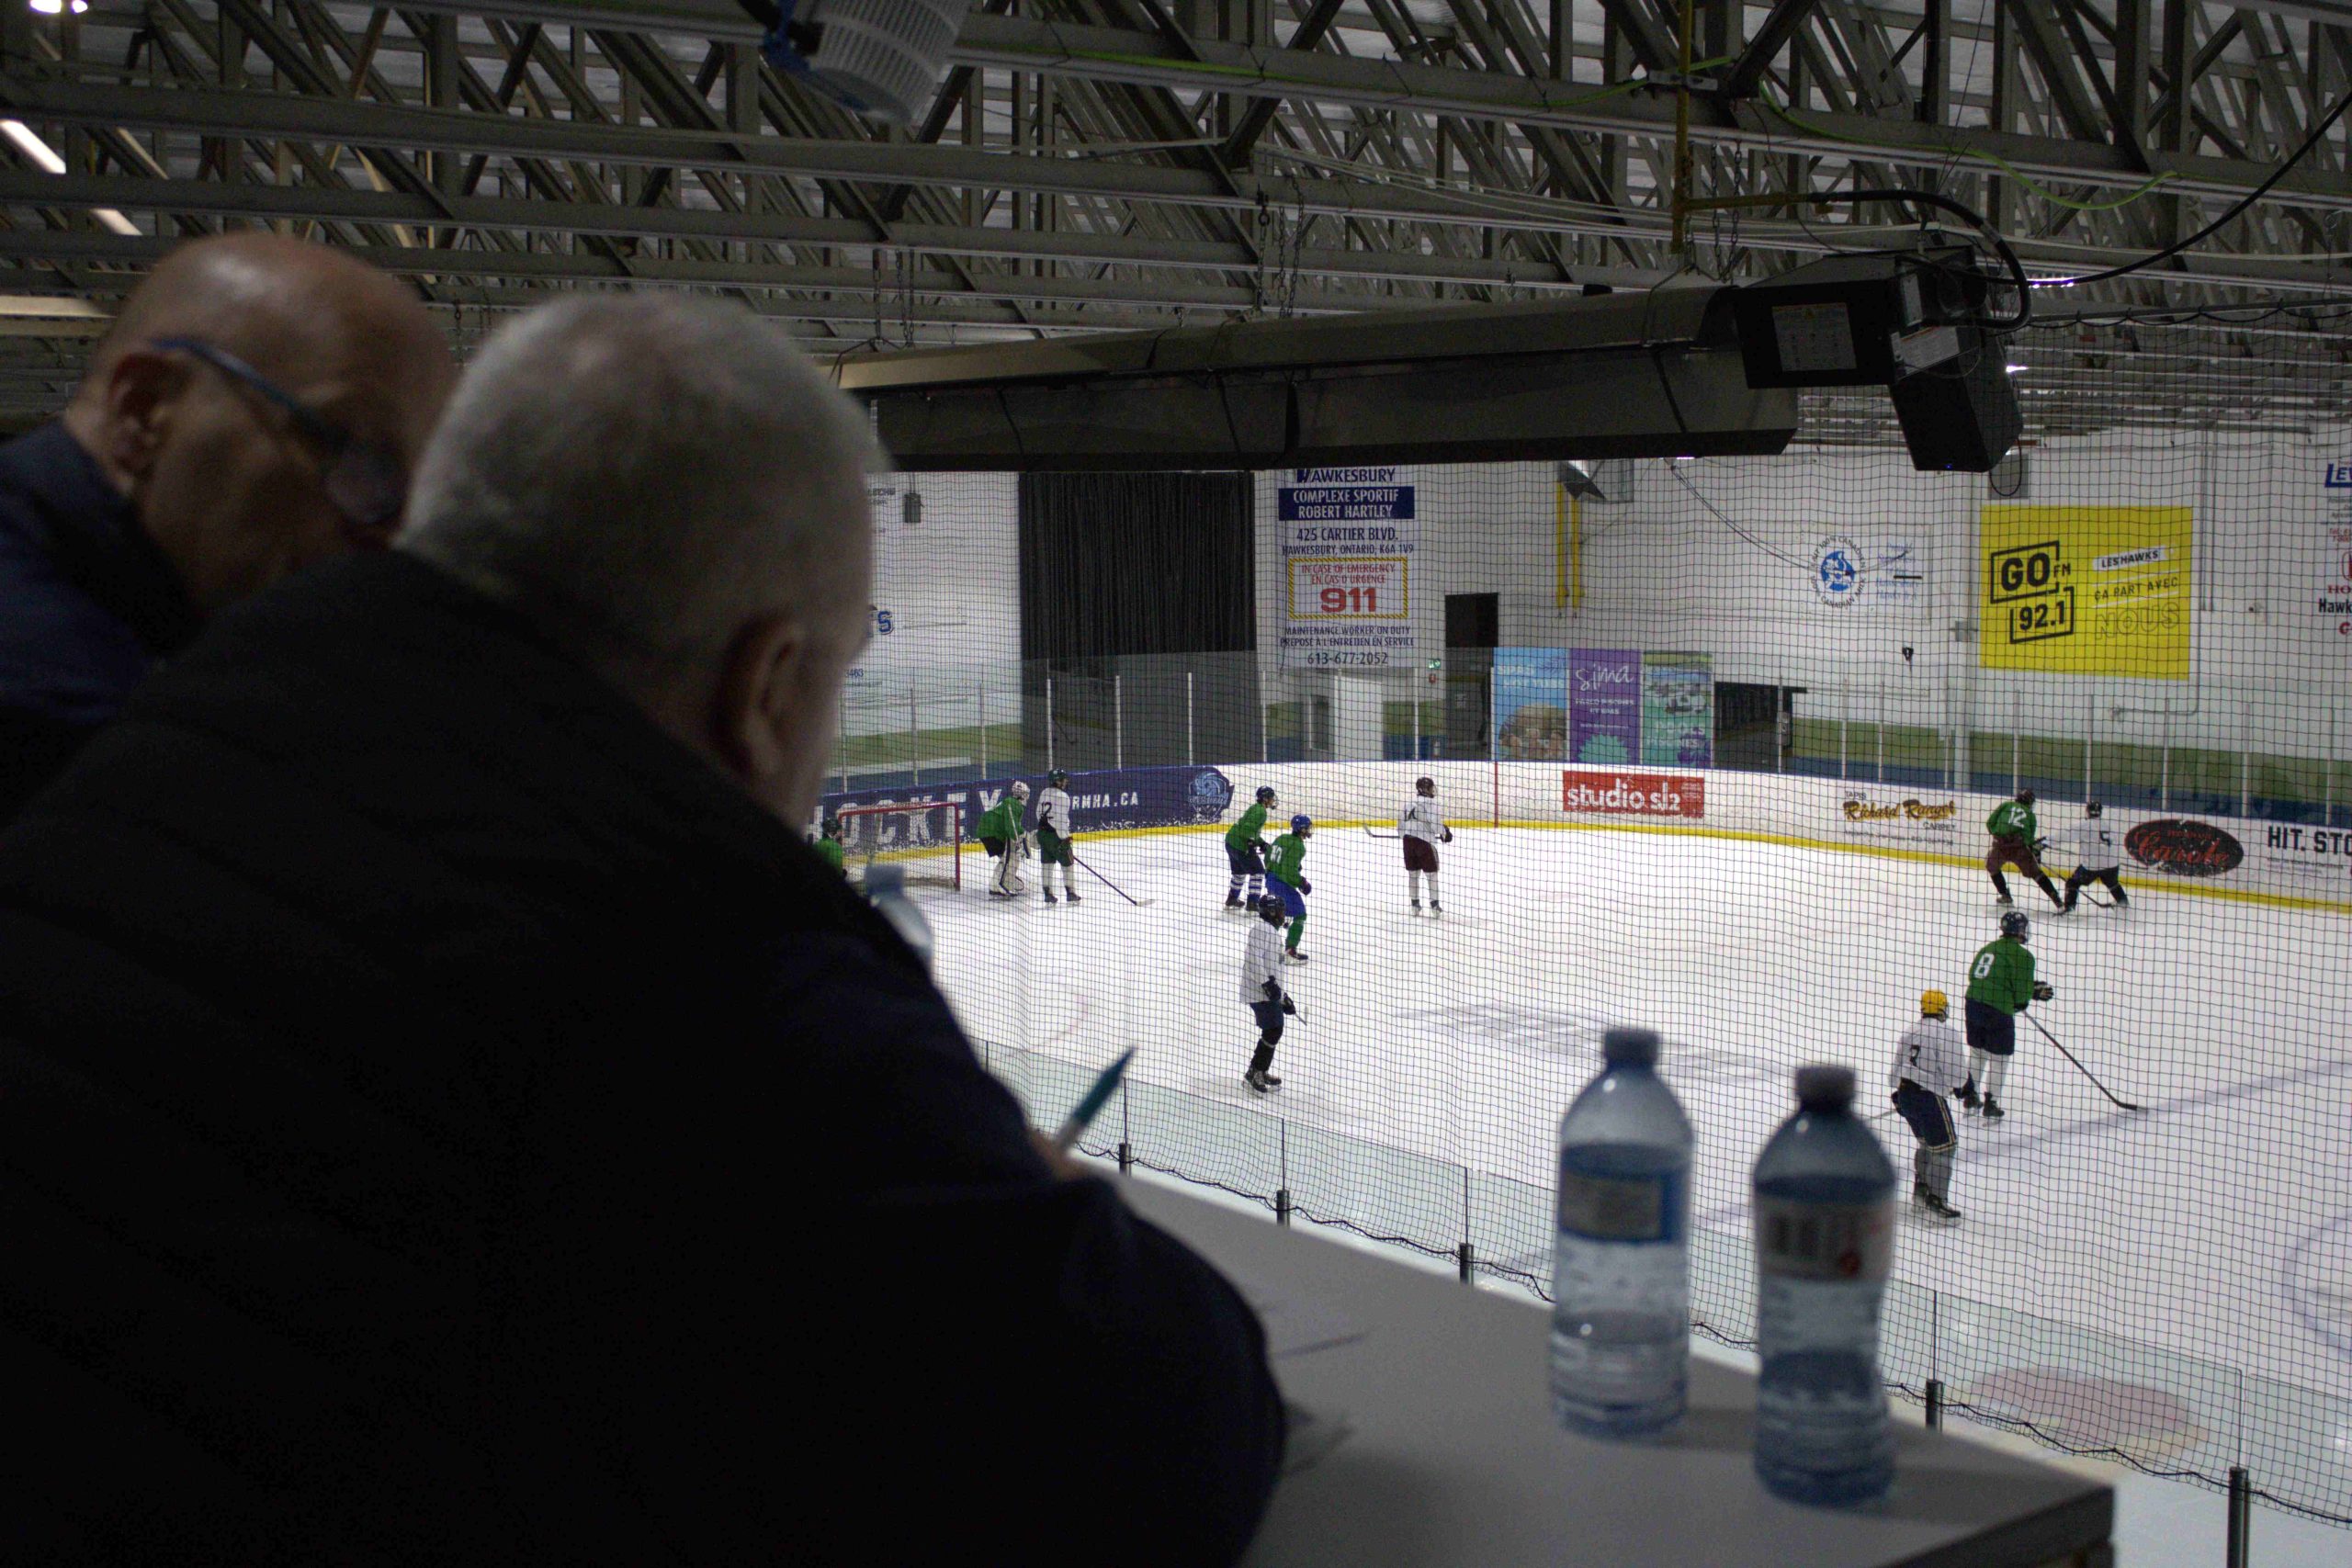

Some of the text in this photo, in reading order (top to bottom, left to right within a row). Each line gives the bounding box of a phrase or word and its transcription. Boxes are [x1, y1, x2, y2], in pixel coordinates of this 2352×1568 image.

[1296, 468, 1396, 483] HAWKESBURY
[1294, 489, 1399, 503] COMPLEXE SPORTIF
[1298, 505, 1393, 519] ROBERT HARTLEY
[1297, 526, 1398, 541] 425 CARTIER BLVD.
[1379, 544, 1396, 555] K6A
[1302, 563, 1396, 573] IN CASE OF EMERGENCY
[2000, 552, 2071, 592] GO FM
[1312, 575, 1321, 585] EN
[1324, 575, 1340, 585] CAS
[2113, 583, 2142, 597] PART
[2147, 577, 2178, 591] AVEC
[1320, 587, 1377, 614] 911
[2018, 600, 2065, 632] 92.1
[2095, 602, 2179, 640] NOUS
[1285, 626, 1411, 636] MAINTENANCE WORKER ON DUTY
[1373, 637, 1383, 647] EN
[1385, 637, 1415, 647] SERVICE
[1307, 651, 1389, 665] 613-677-2052
[1566, 777, 1645, 810] studio
[2007, 806, 2027, 829] 12
[2267, 826, 2306, 852] HIT.
[1973, 953, 1995, 979] 8
